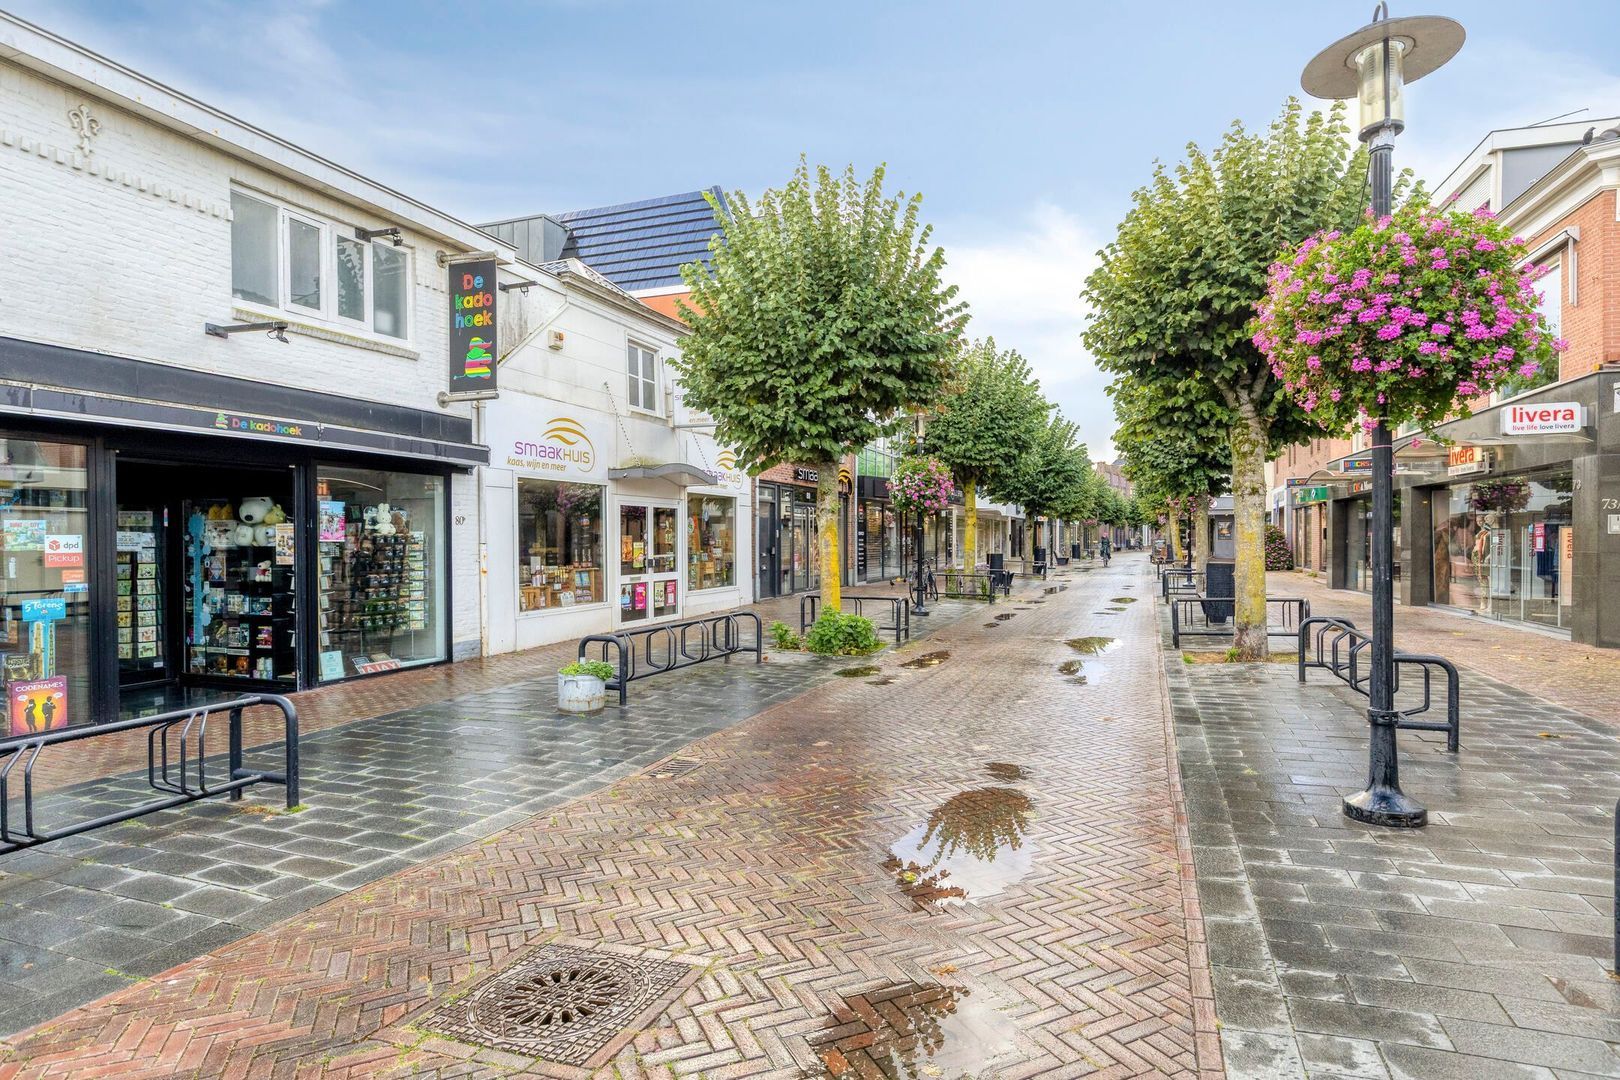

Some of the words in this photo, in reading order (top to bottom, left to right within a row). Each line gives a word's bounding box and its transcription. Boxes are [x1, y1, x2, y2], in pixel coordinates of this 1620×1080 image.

[463, 274, 484, 290] De
[455, 291, 493, 310] kado
[455, 309, 493, 329] hoek
[1512, 407, 1575, 424] livera
[232, 417, 248, 429] De
[249, 419, 303, 436] kadohoek
[526, 459, 541, 470] wijn
[542, 461, 549, 469] en
[550, 463, 567, 472] meer
[63, 541, 79, 550] dpd
[48, 554, 80, 563] Pickup
[15, 681, 64, 693] CODENAMES
